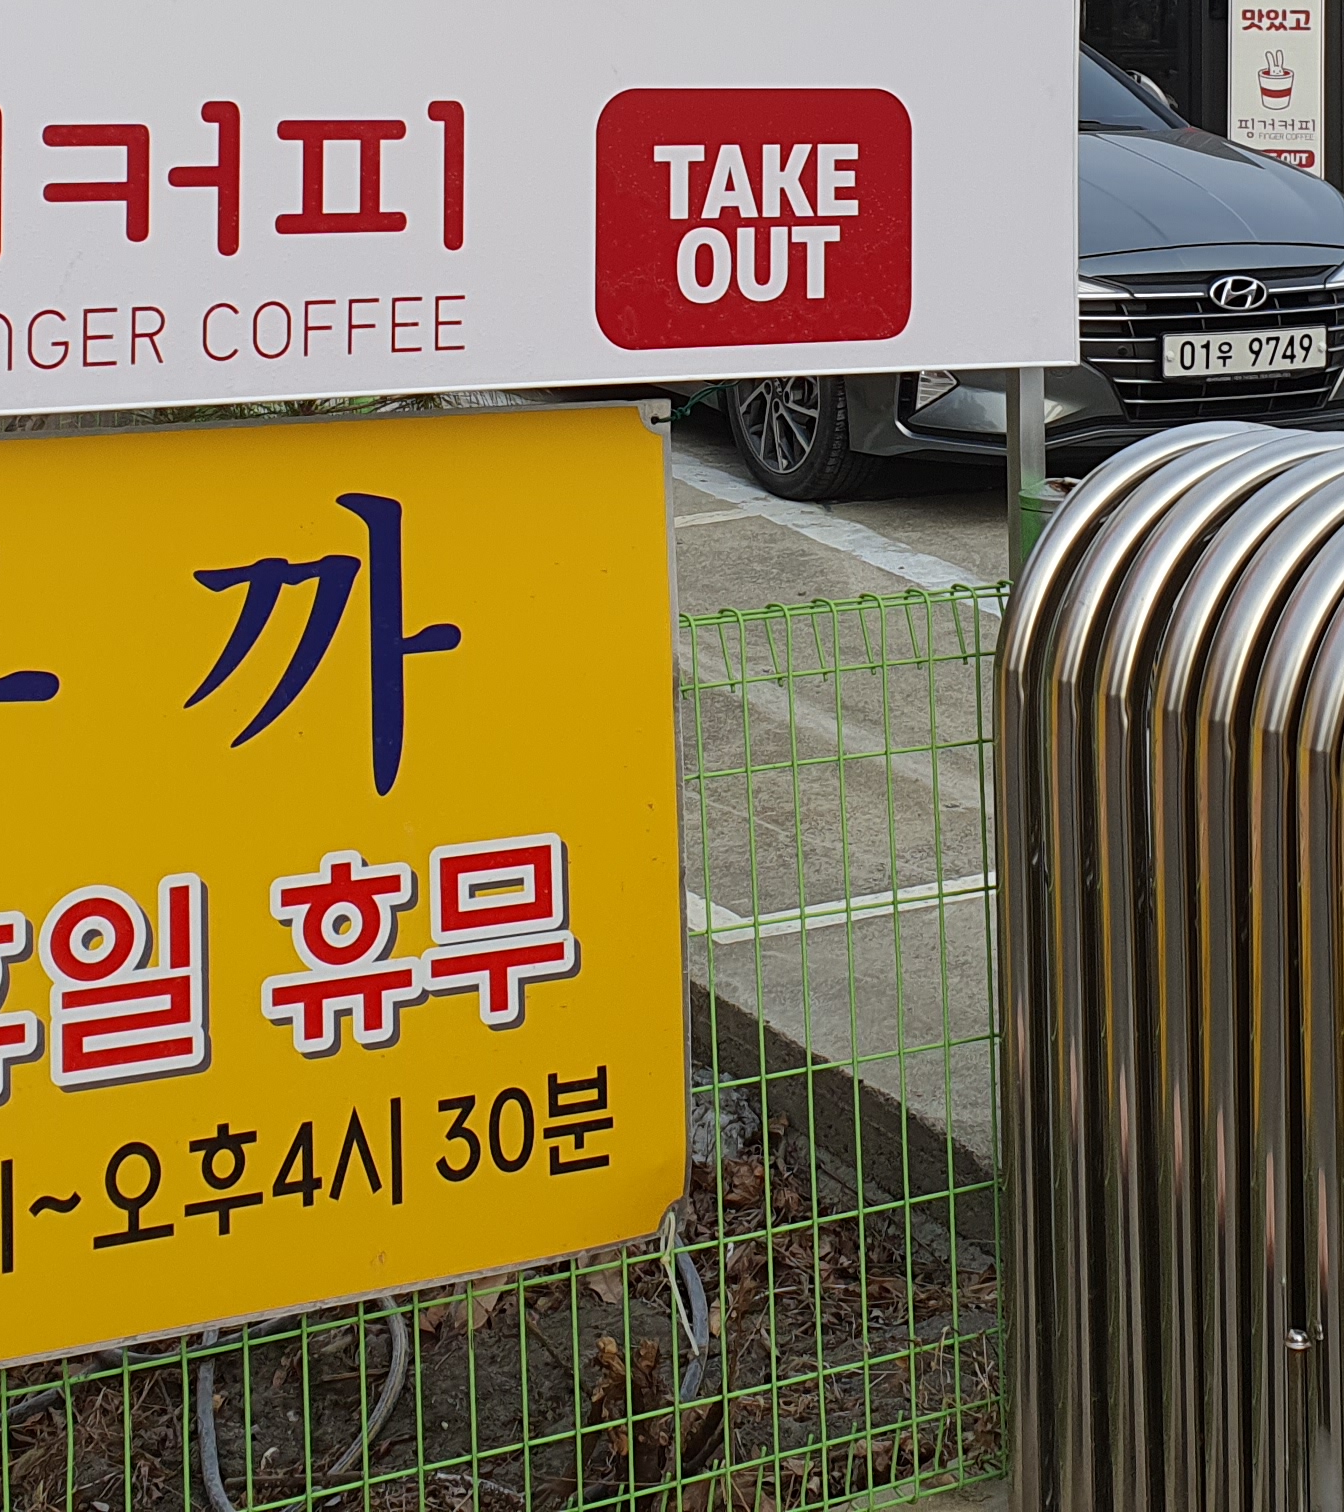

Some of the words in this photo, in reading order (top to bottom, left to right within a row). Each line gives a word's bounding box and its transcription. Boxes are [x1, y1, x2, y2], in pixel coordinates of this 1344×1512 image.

[1241, 8, 1312, 32] 맛있고
[1237, 117, 1316, 139] 핑거커피
[653, 142, 859, 221] TAKE
[675, 224, 841, 305] OUT
[201, 293, 466, 363] COFFEE
[1179, 340, 1234, 371] 01우
[1248, 333, 1313, 367] 9749
[261, 833, 577, 1056] 휴무
[435, 1064, 615, 1184] 30분
